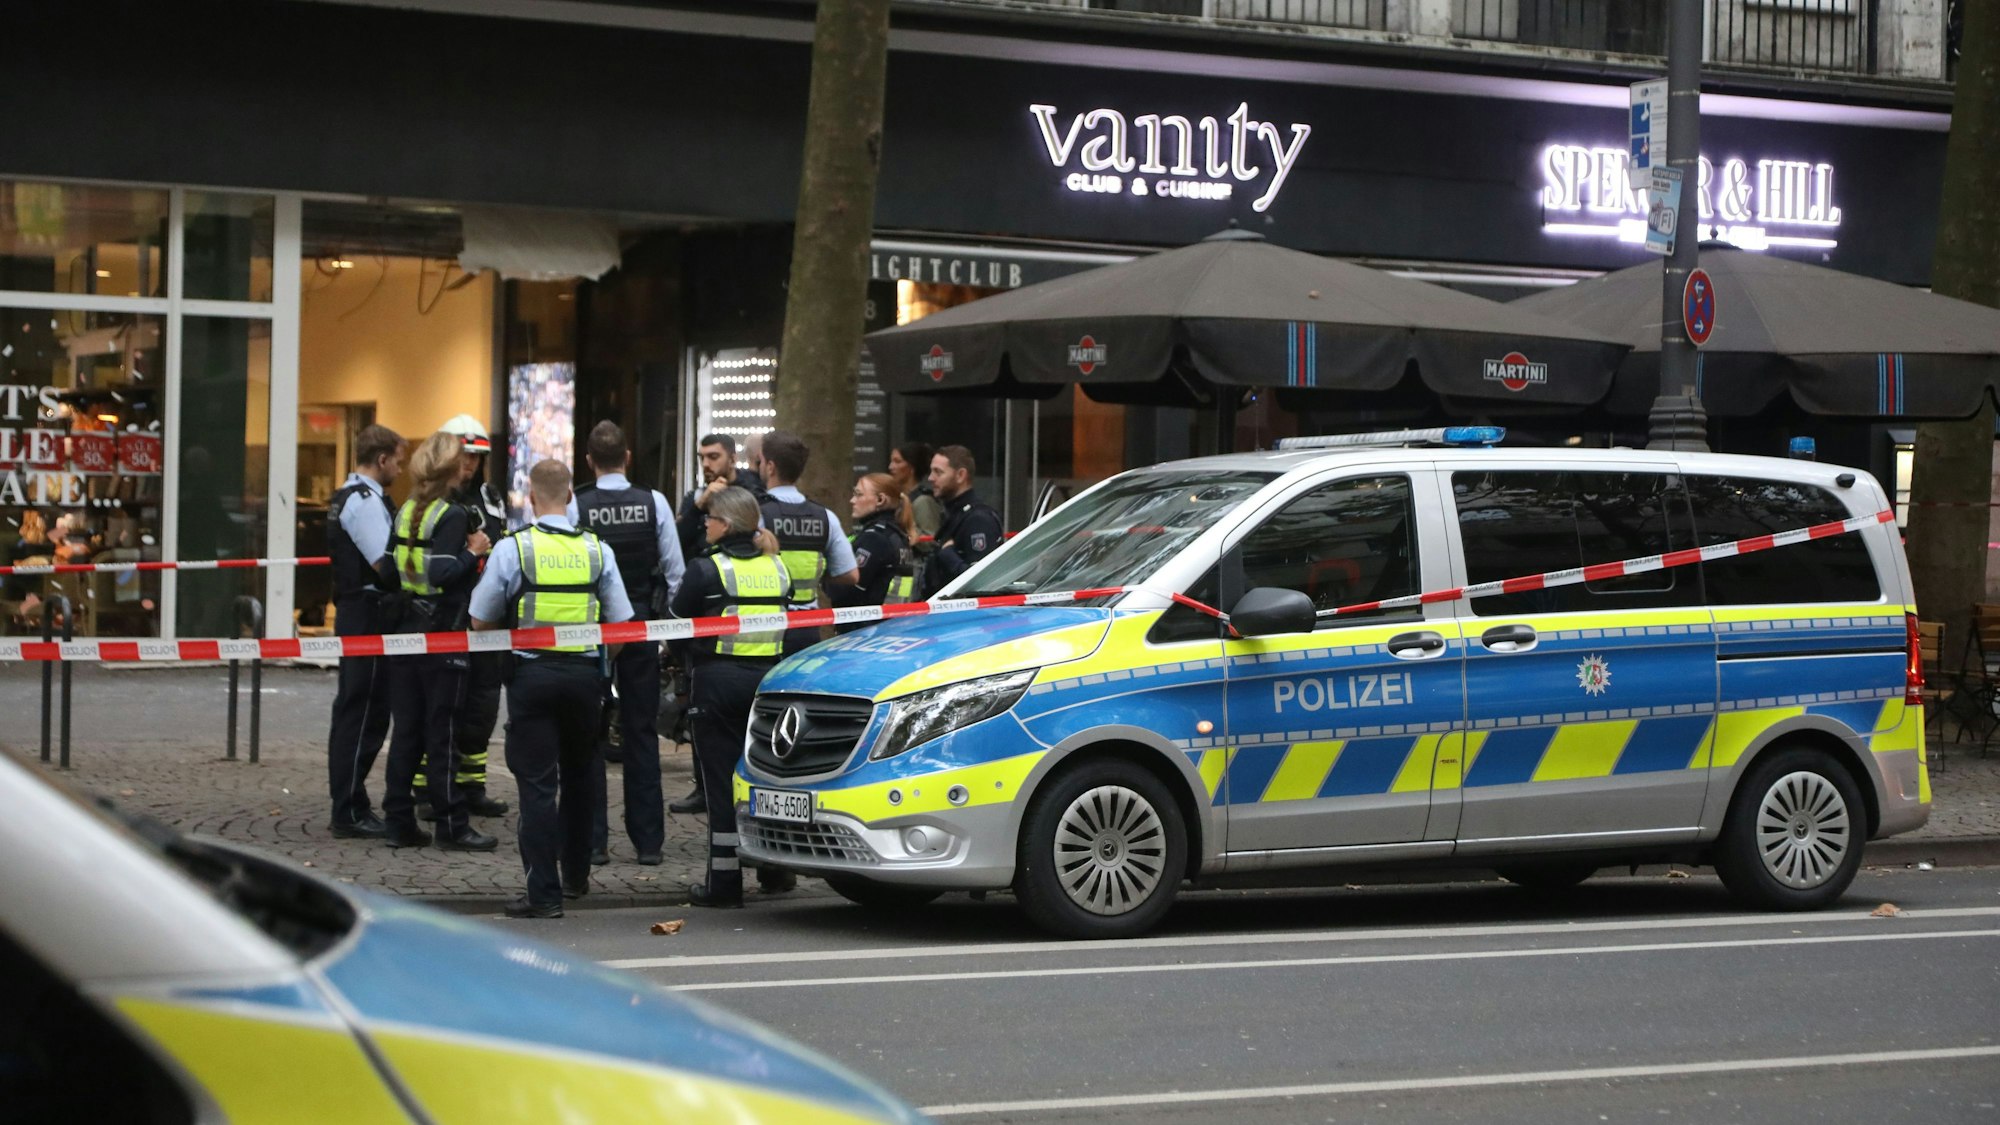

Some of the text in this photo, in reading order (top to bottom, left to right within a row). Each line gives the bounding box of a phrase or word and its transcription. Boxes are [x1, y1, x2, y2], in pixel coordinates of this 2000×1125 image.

[1029, 101, 1311, 212] vanity
[1066, 172, 1122, 194] CLUB
[1544, 144, 1841, 226] SPENR & HILL
[872, 254, 1022, 288] IGHTCLUB
[921, 356, 953, 371] MARTINI
[1069, 346, 1106, 362] MARTINI
[1486, 362, 1544, 380] MARTINI
[0, 428, 56, 463] LE
[589, 505, 648, 526] POLIZEI
[773, 518, 823, 537] POLIZEI
[540, 554, 586, 569] POLIZEI
[738, 574, 778, 589] POLIZEI
[1273, 672, 1413, 713] POLIZEI
[755, 792, 809, 819] NRW 5-6508
